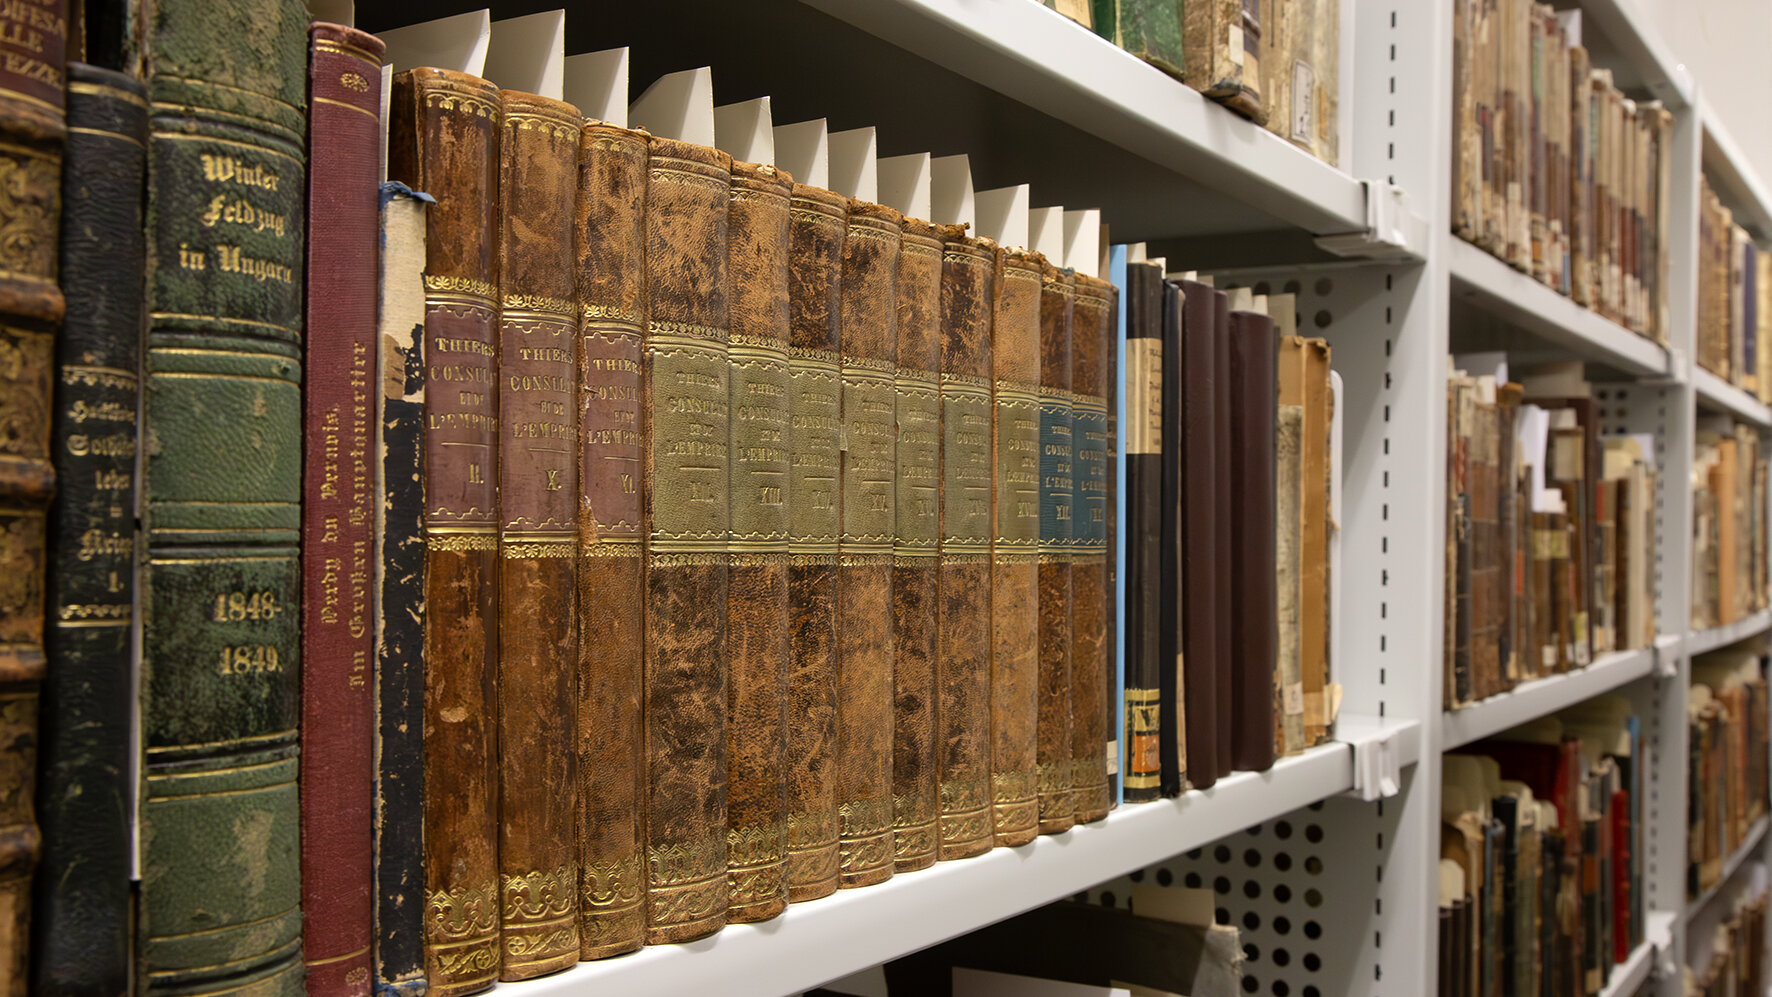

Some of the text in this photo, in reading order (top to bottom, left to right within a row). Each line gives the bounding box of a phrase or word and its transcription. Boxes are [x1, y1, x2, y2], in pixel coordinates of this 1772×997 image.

[200, 154, 280, 191] Winter
[201, 194, 285, 237] Feldzug
[179, 243, 206, 270] in
[434, 336, 496, 358] THIERS
[519, 347, 574, 365] THIERS
[320, 517, 338, 543] du
[213, 591, 283, 621] 1848-
[320, 557, 340, 625] Verdy
[349, 650, 366, 691] Im
